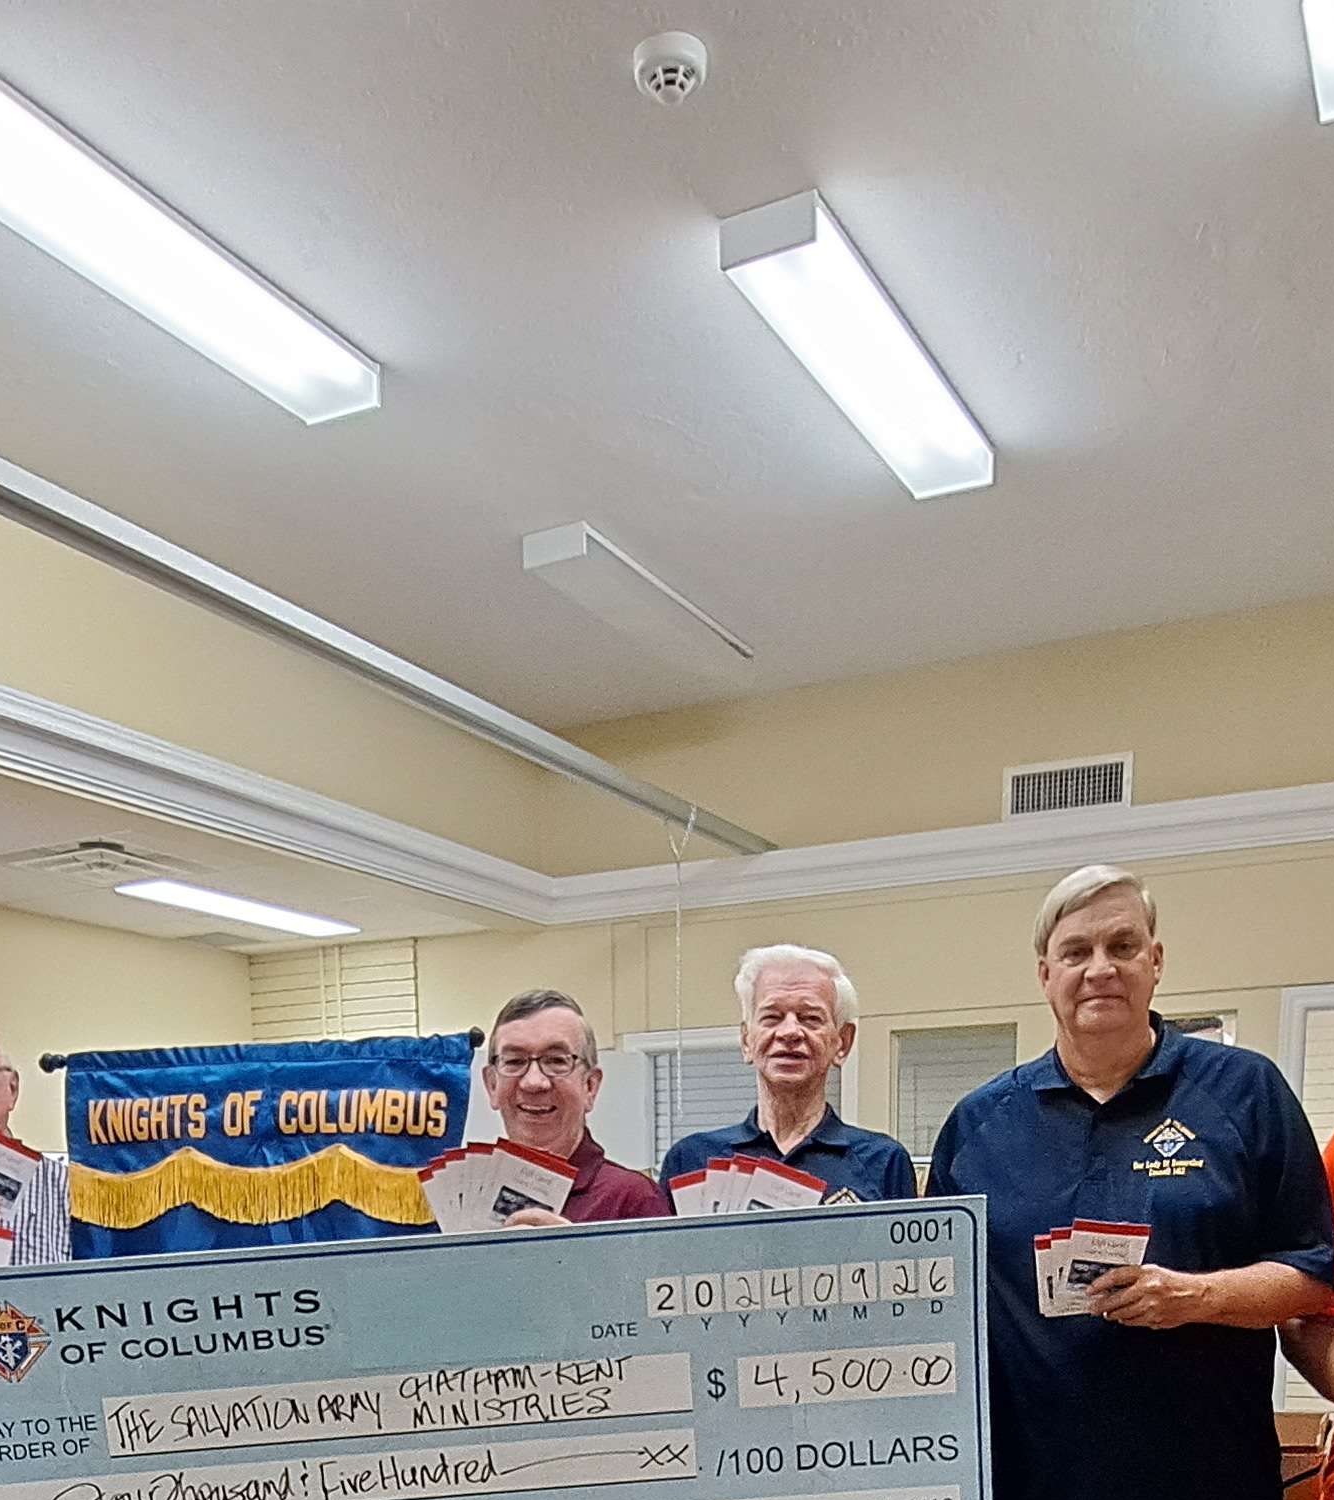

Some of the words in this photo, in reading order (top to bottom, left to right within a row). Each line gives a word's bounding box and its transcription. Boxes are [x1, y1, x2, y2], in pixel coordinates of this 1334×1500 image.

[88, 1093, 208, 1145] KNIGHTS
[223, 1091, 263, 1137] OF
[278, 1088, 449, 1138] COLUMBUS
[889, 1217, 954, 1244] 0001
[54, 1289, 322, 1332] KNIGHTS
[591, 1321, 638, 1340] DATE
[60, 1341, 108, 1365] OF
[121, 1325, 326, 1361] COLUMBUS
[706, 1367, 727, 1402] $
[20, 1418, 52, 1438] TO
[54, 1414, 98, 1435] THE
[108, 1401, 165, 1450] THE
[170, 1395, 310, 1442] SALVATION
[317, 1390, 383, 1430] ARMY
[413, 1386, 612, 1429] MINISTRIES
[61, 1437, 92, 1457] OF
[716, 1446, 784, 1477] /100
[796, 1434, 959, 1471] DOLLARS
[378, 1449, 501, 1492] Hundred
